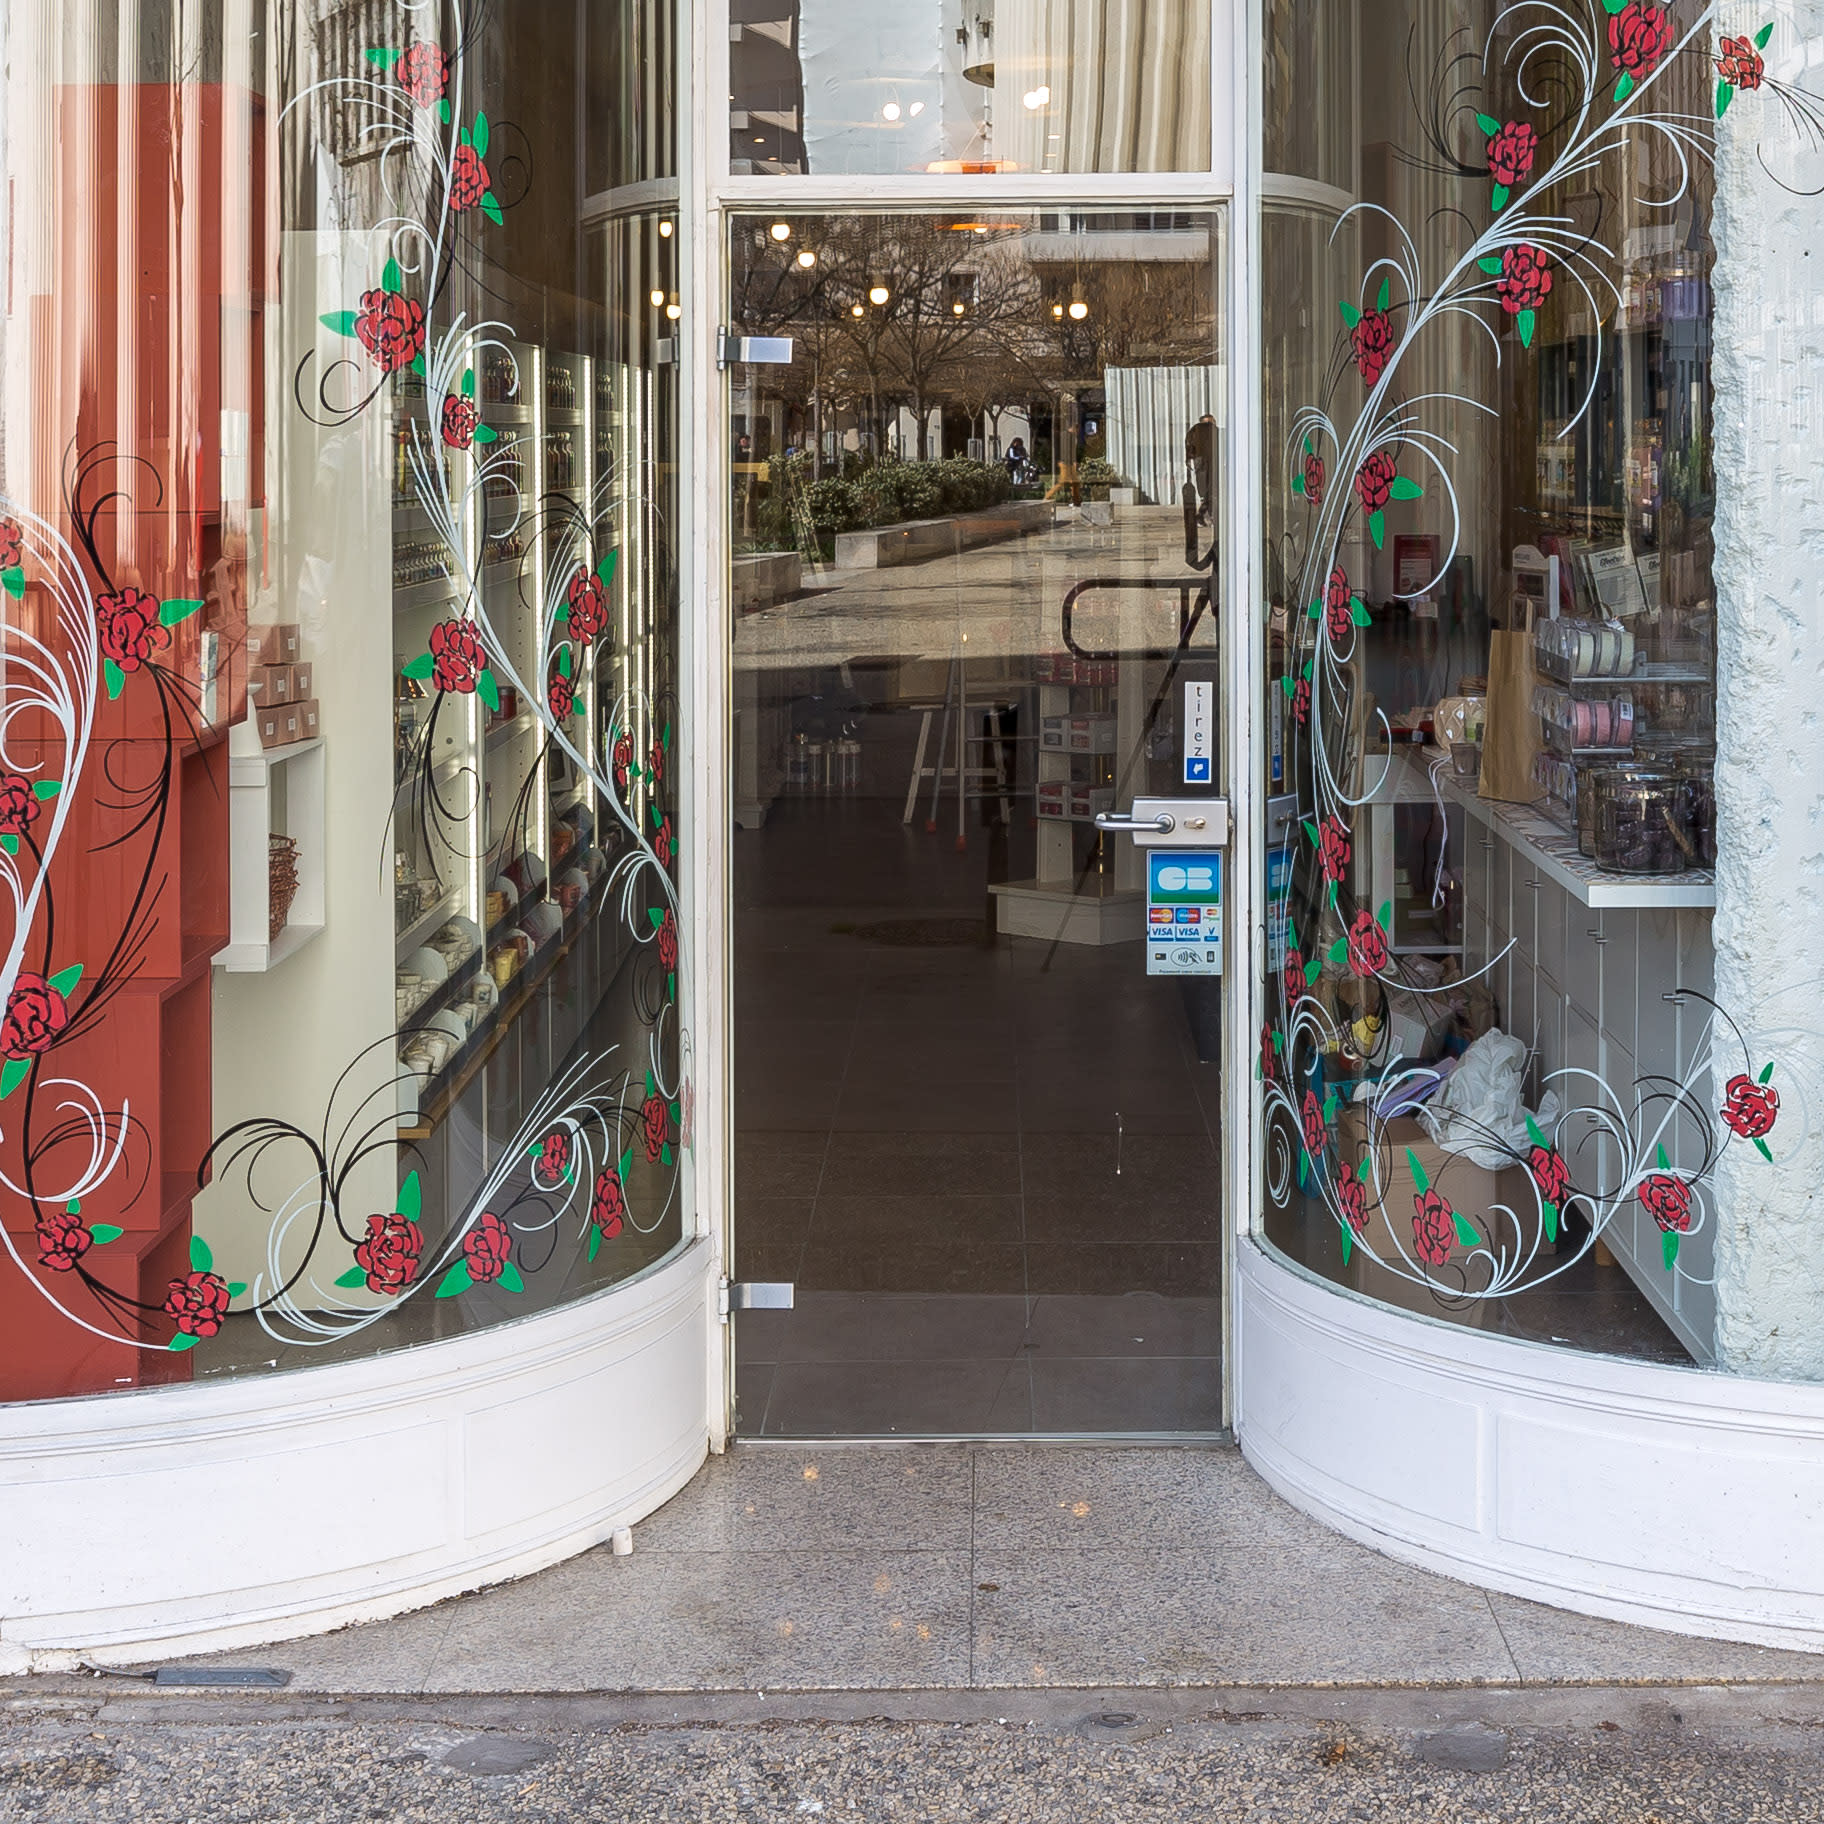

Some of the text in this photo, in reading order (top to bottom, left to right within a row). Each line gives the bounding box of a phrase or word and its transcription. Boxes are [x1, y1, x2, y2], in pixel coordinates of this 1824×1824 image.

[1194, 686, 1203, 757] tirez
[1152, 927, 1200, 936] VISA VISA
